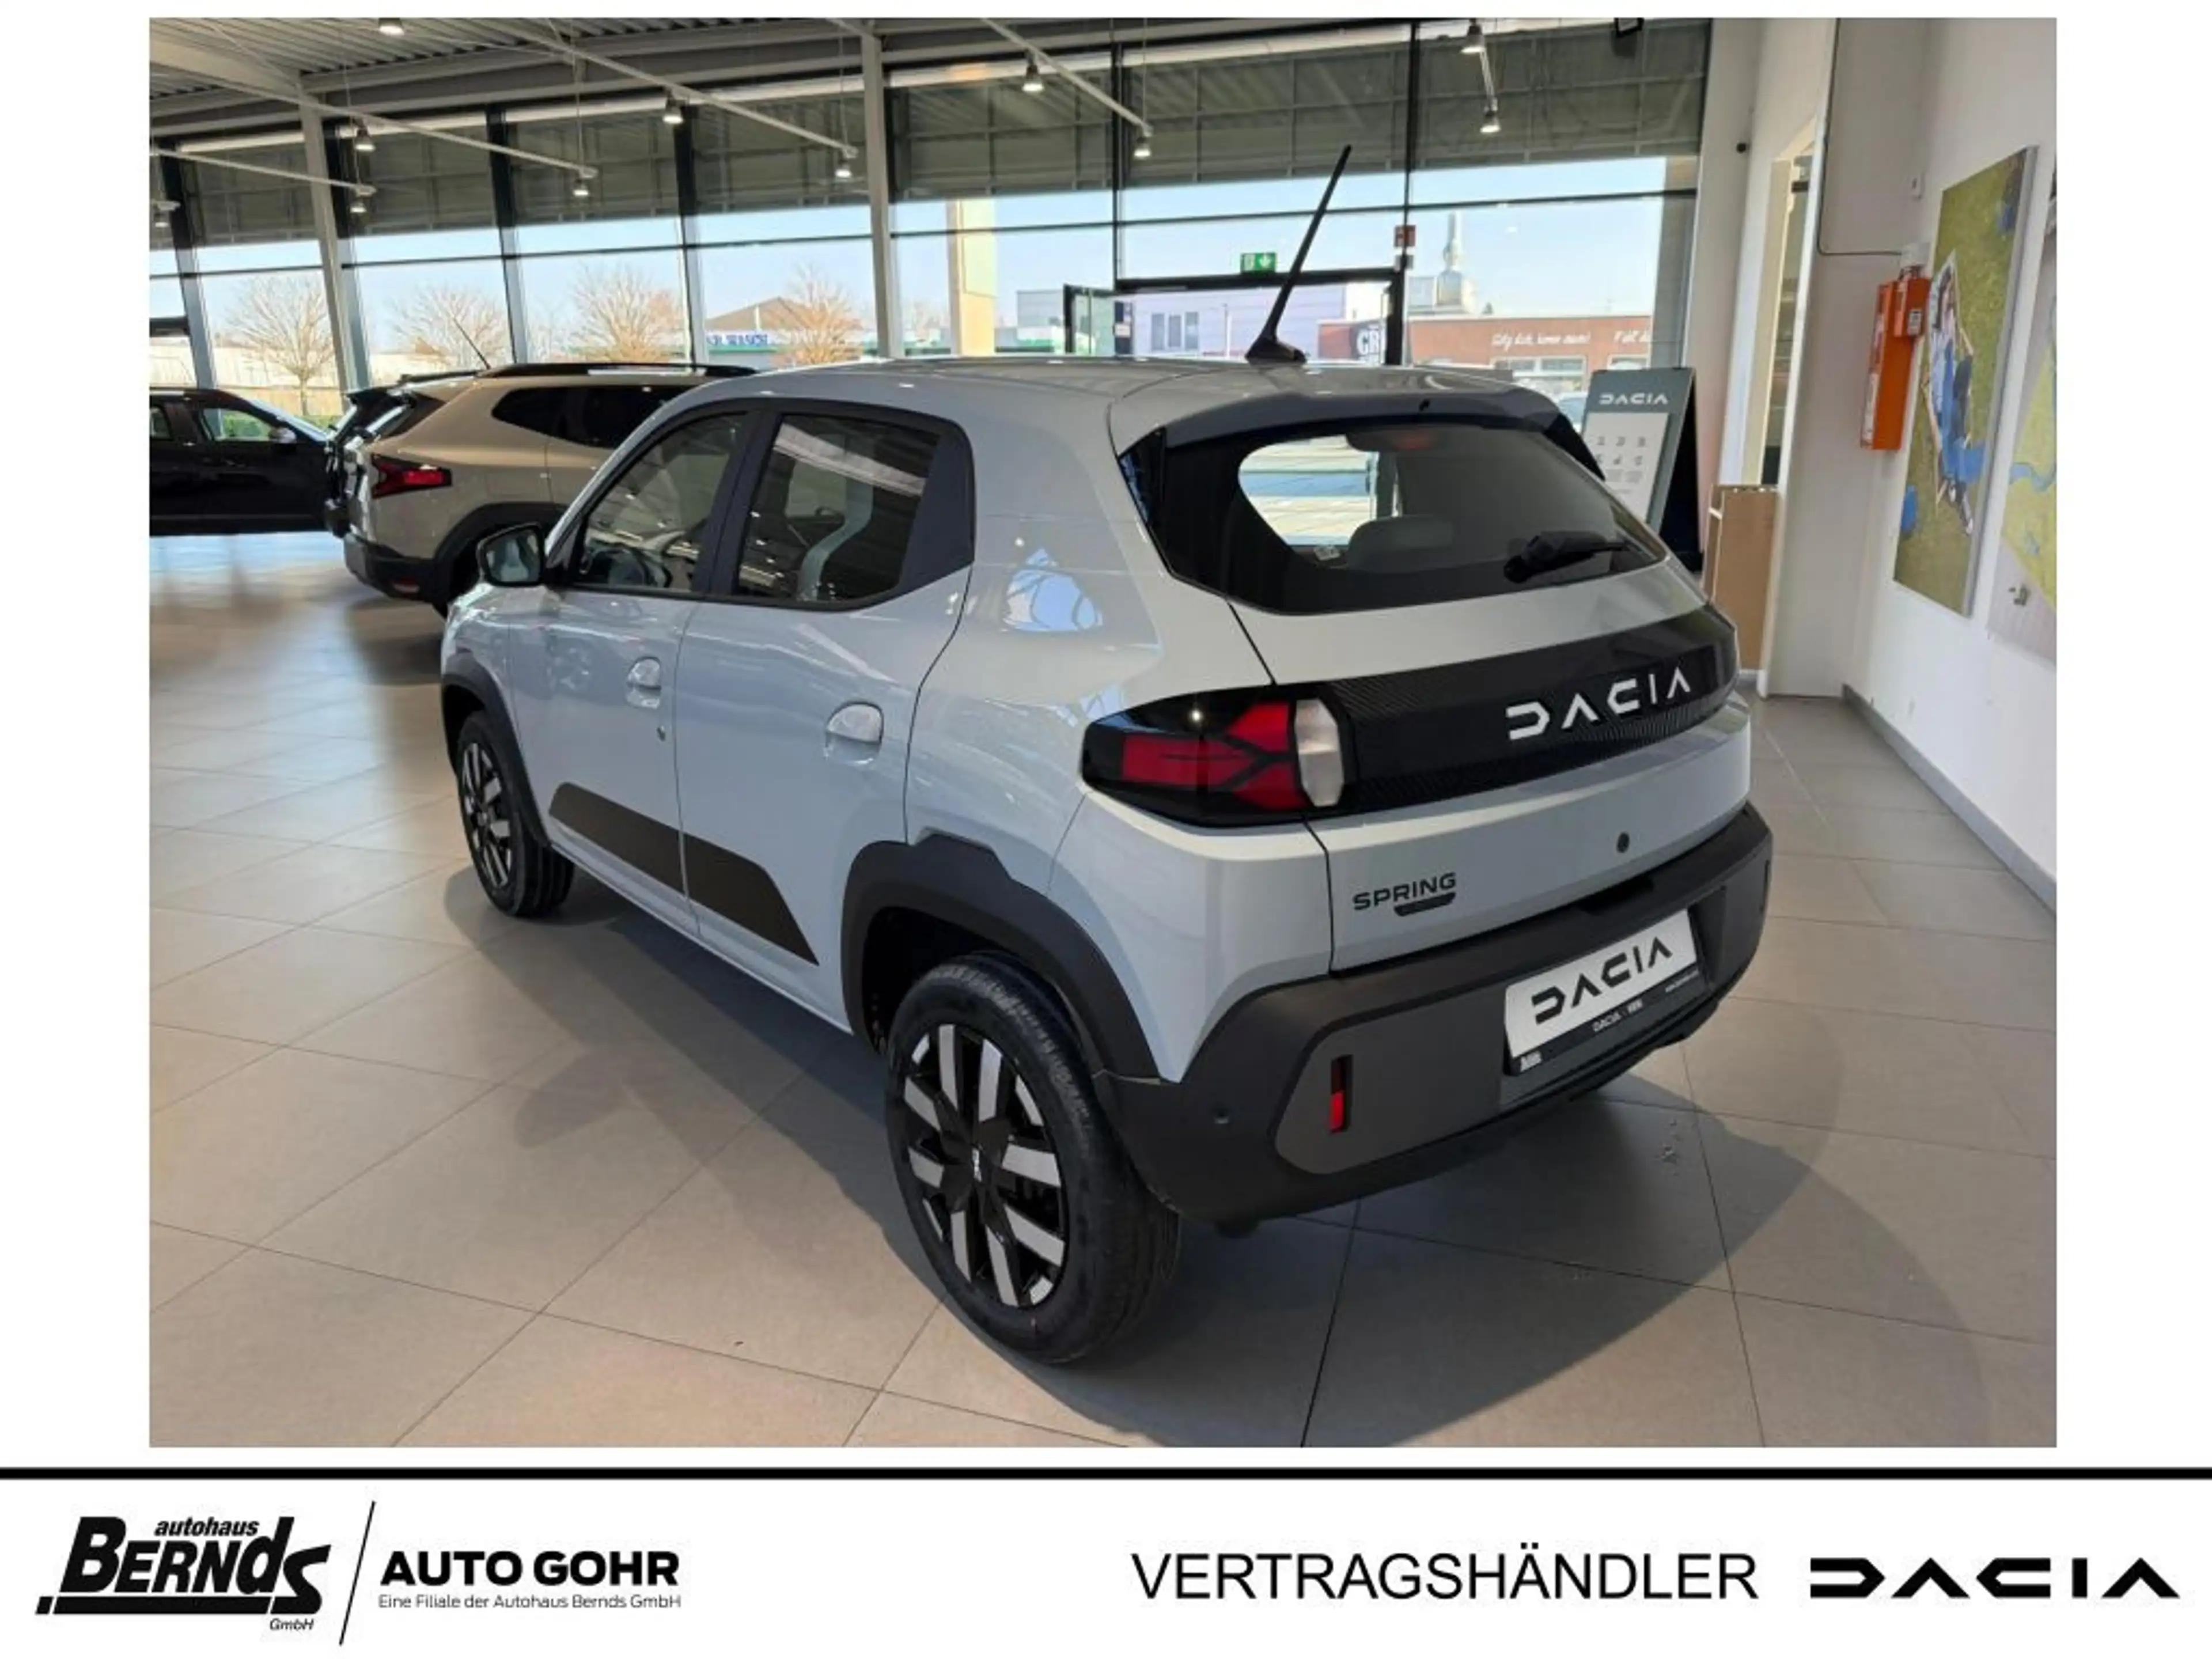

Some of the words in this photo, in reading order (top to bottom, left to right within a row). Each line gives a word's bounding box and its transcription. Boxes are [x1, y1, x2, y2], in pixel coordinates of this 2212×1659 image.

[1599, 393, 1669, 406] DACIA
[1506, 666, 1691, 741] DACIA
[1352, 872, 1456, 910] SPRING
[1531, 937, 1673, 1025] DACIA
